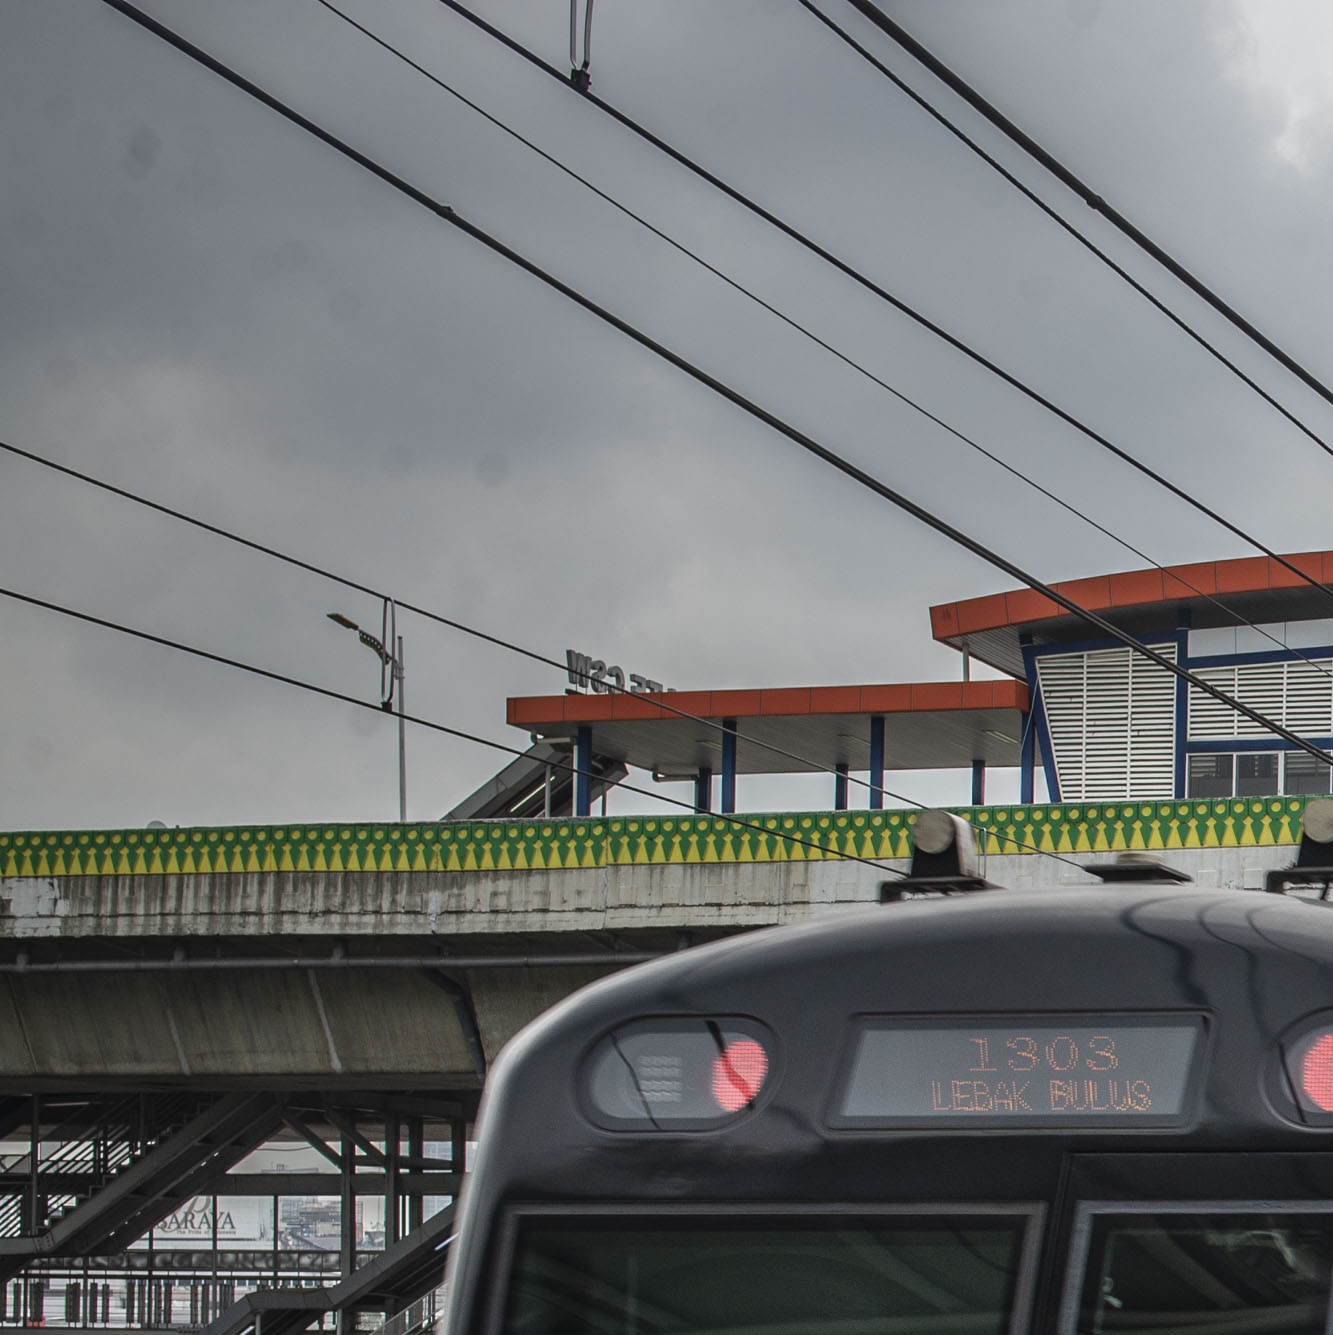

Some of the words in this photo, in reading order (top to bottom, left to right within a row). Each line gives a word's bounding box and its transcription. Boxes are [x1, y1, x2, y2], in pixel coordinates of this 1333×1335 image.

[968, 1035, 1119, 1072] 1303
[930, 1079, 1033, 1112] LEBAK
[1049, 1079, 1152, 1112] BULUS
